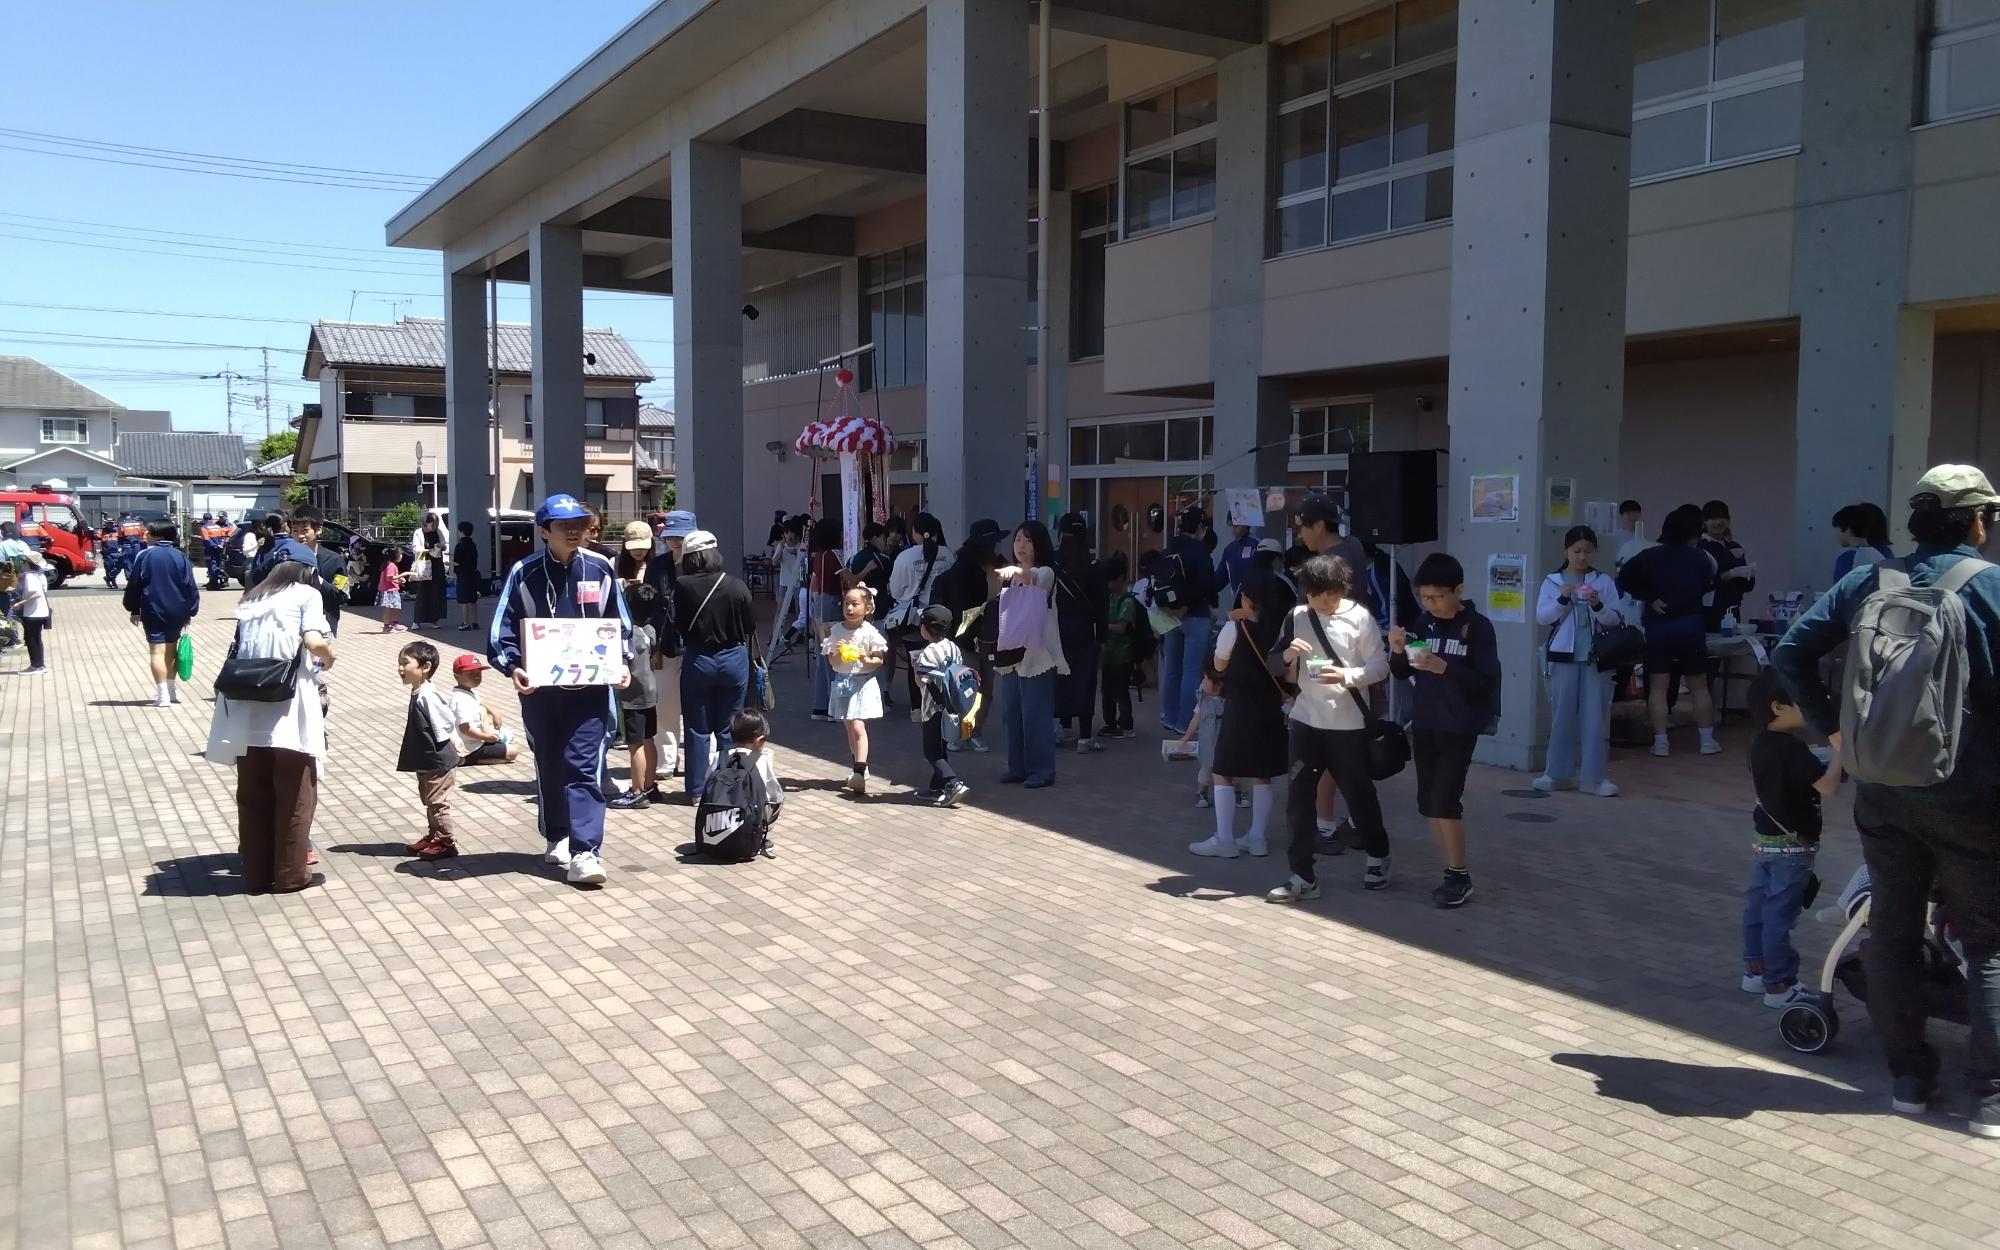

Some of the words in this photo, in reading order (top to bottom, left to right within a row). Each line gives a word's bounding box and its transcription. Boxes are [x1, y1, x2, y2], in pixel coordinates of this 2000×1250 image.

[550, 663, 615, 685] クラフト
[706, 808, 741, 833] NIKE
